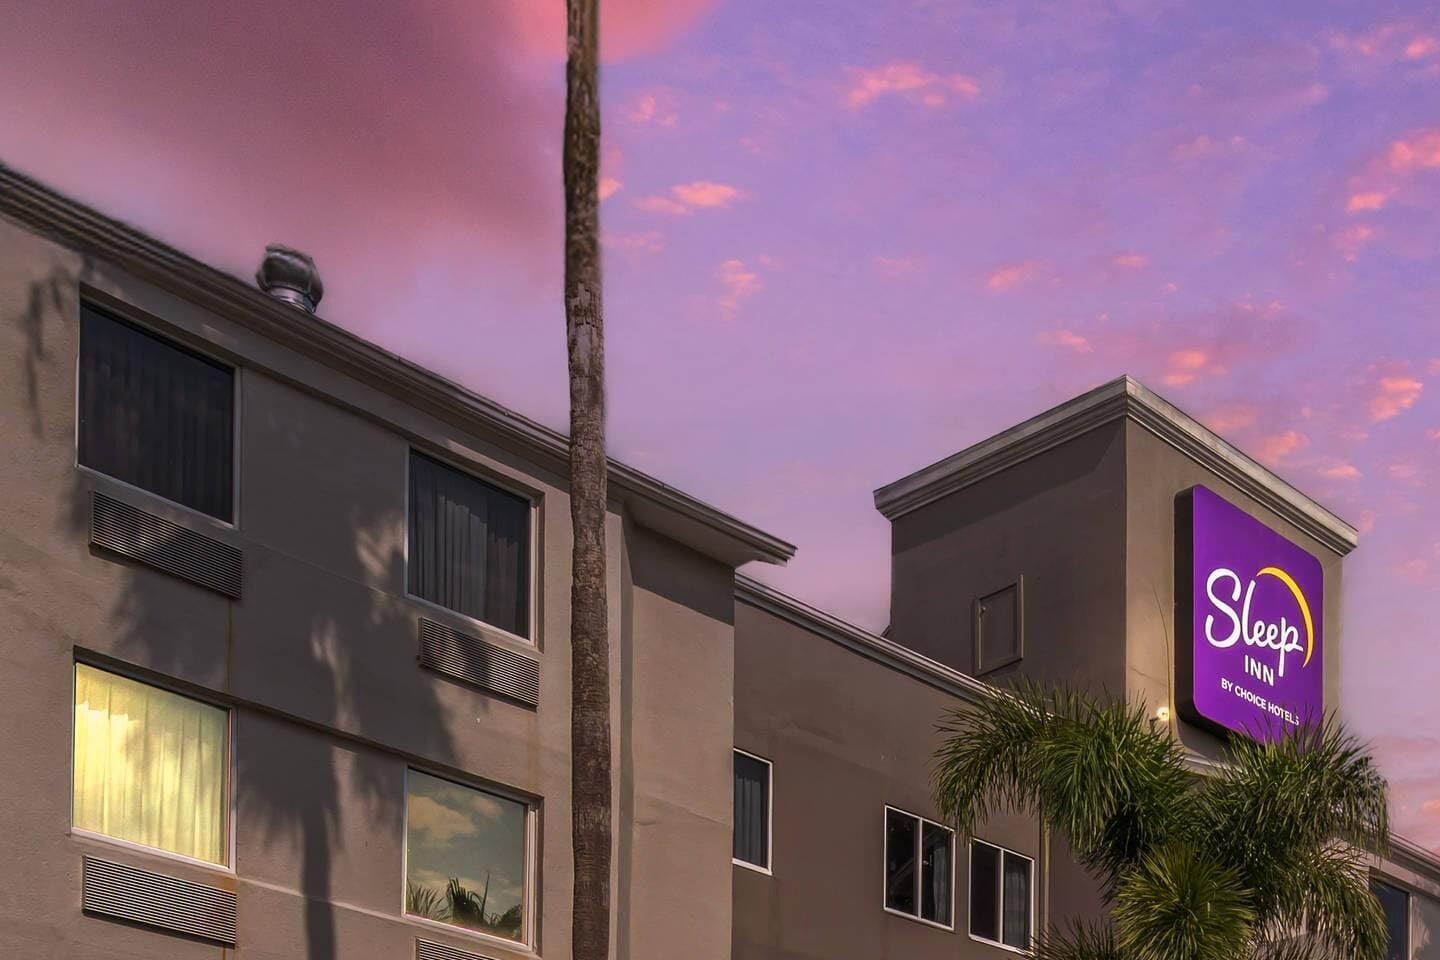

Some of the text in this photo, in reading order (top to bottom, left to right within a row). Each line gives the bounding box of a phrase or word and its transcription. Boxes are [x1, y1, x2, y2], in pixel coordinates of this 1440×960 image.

[1205, 568, 1303, 677] Sleep
[1245, 655, 1274, 686] INN
[1221, 678, 1233, 692] BY
[1234, 685, 1267, 710] CHOICE
